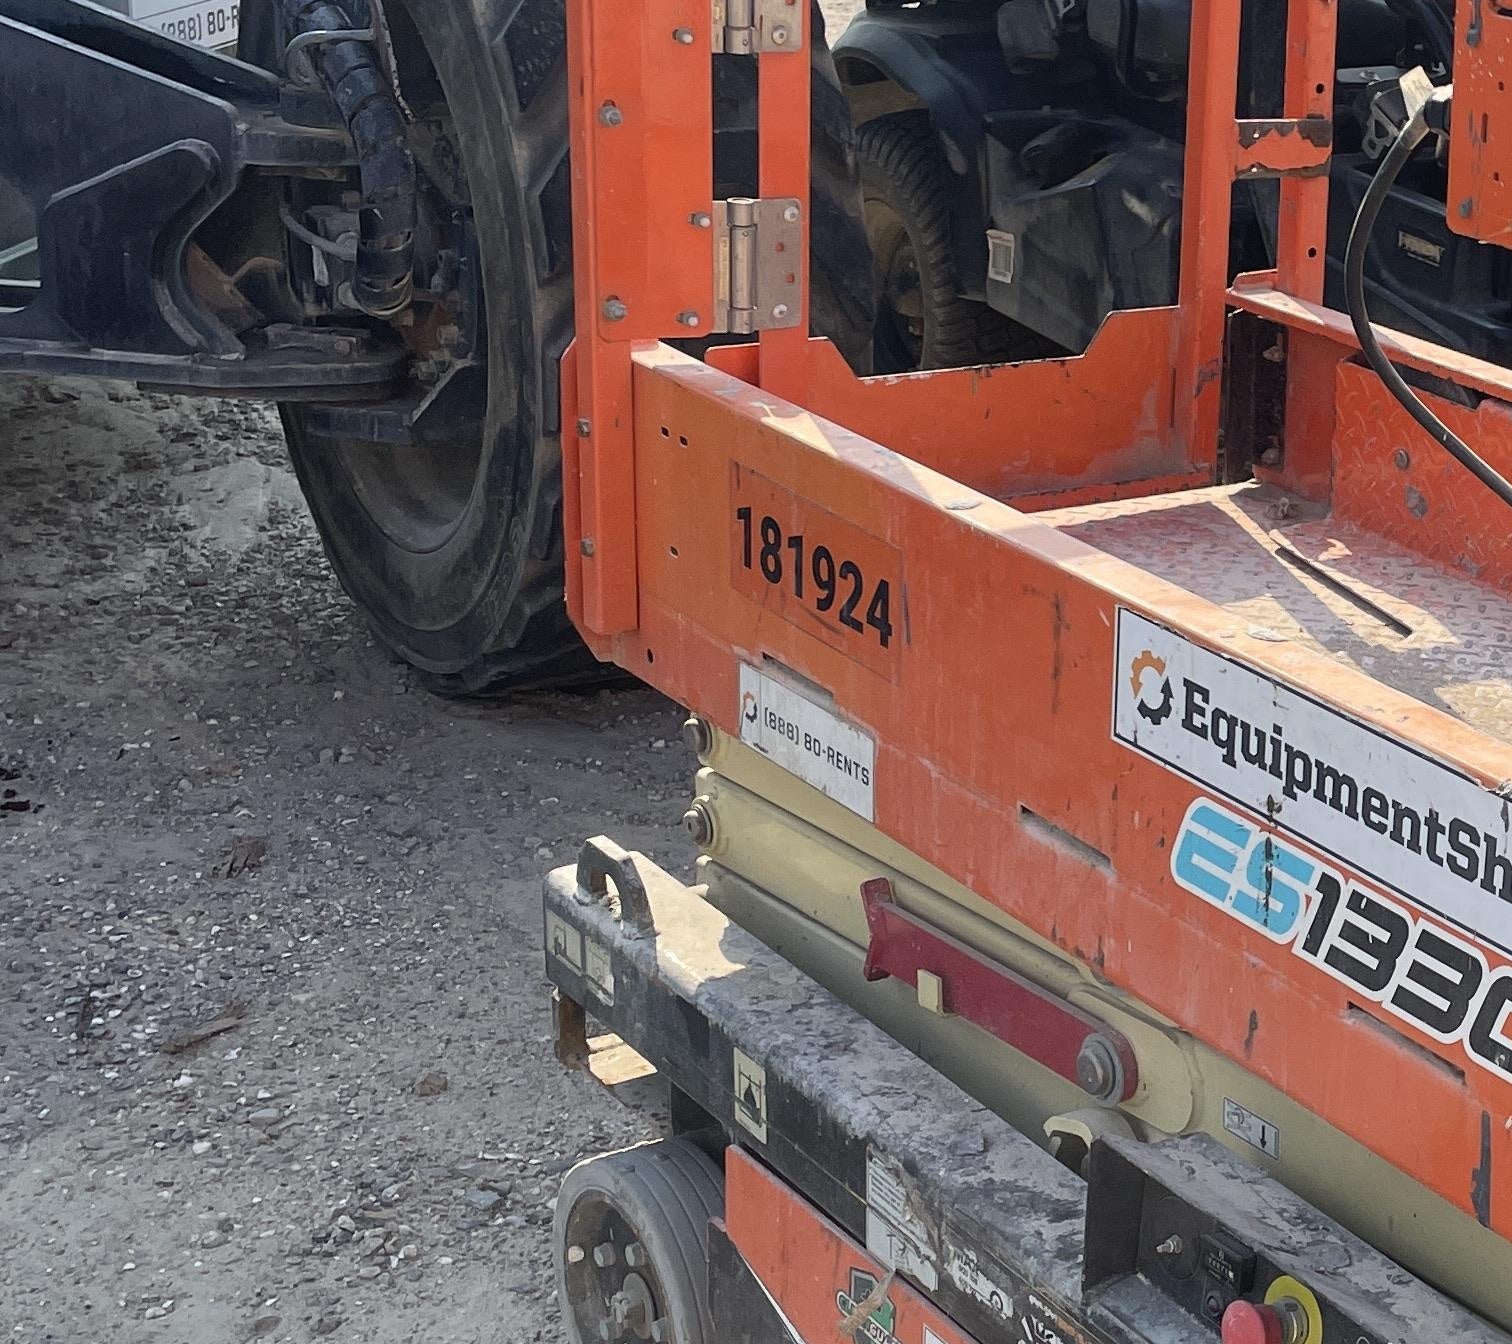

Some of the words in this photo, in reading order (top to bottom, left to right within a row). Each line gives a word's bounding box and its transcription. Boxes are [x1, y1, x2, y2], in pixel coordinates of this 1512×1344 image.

[737, 507, 893, 649] 181924
[764, 707, 800, 745] (888)
[804, 732, 870, 786] 80-RENTS
